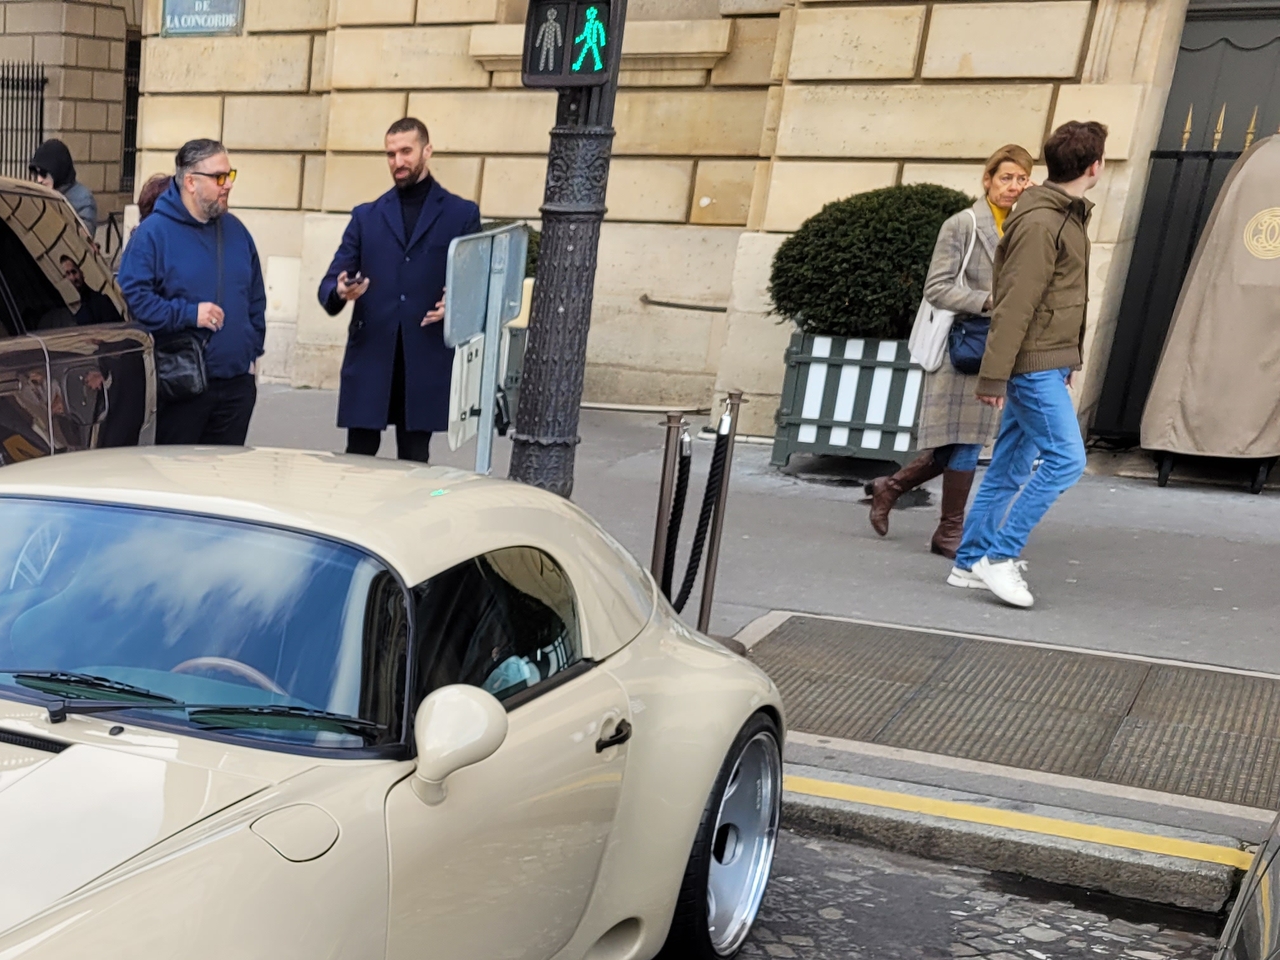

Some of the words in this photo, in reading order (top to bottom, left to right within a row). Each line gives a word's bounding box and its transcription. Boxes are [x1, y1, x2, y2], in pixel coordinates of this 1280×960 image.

[194, 0, 211, 11] DE
[166, 14, 180, 28] LA
[180, 13, 237, 28] CONCORDE
